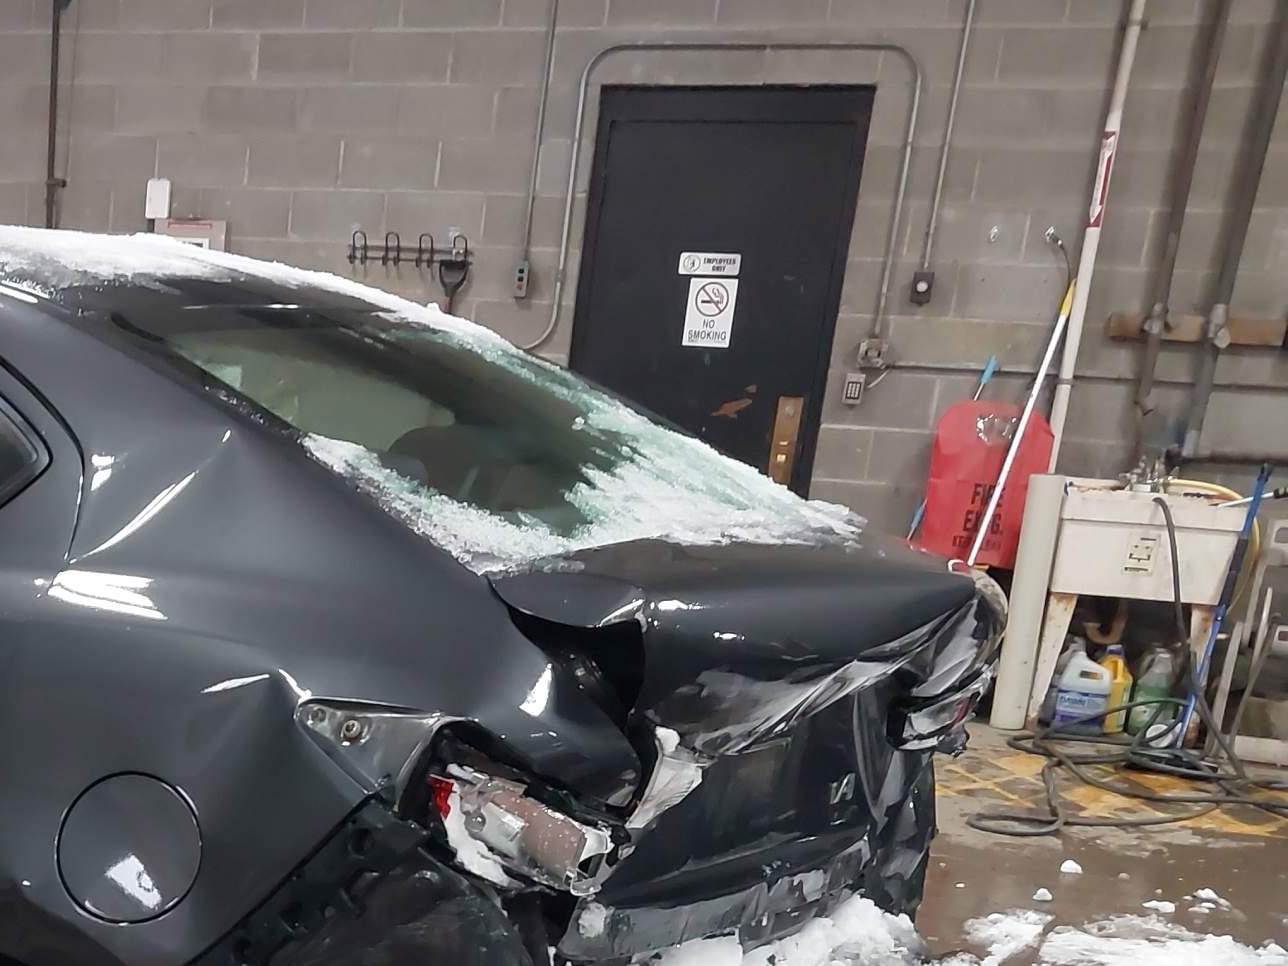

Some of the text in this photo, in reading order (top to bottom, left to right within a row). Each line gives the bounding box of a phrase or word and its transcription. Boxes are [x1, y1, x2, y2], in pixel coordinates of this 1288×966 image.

[703, 257, 736, 265] EMPLOYEES
[702, 319, 716, 329] NO
[687, 329, 727, 341] SMOKING
